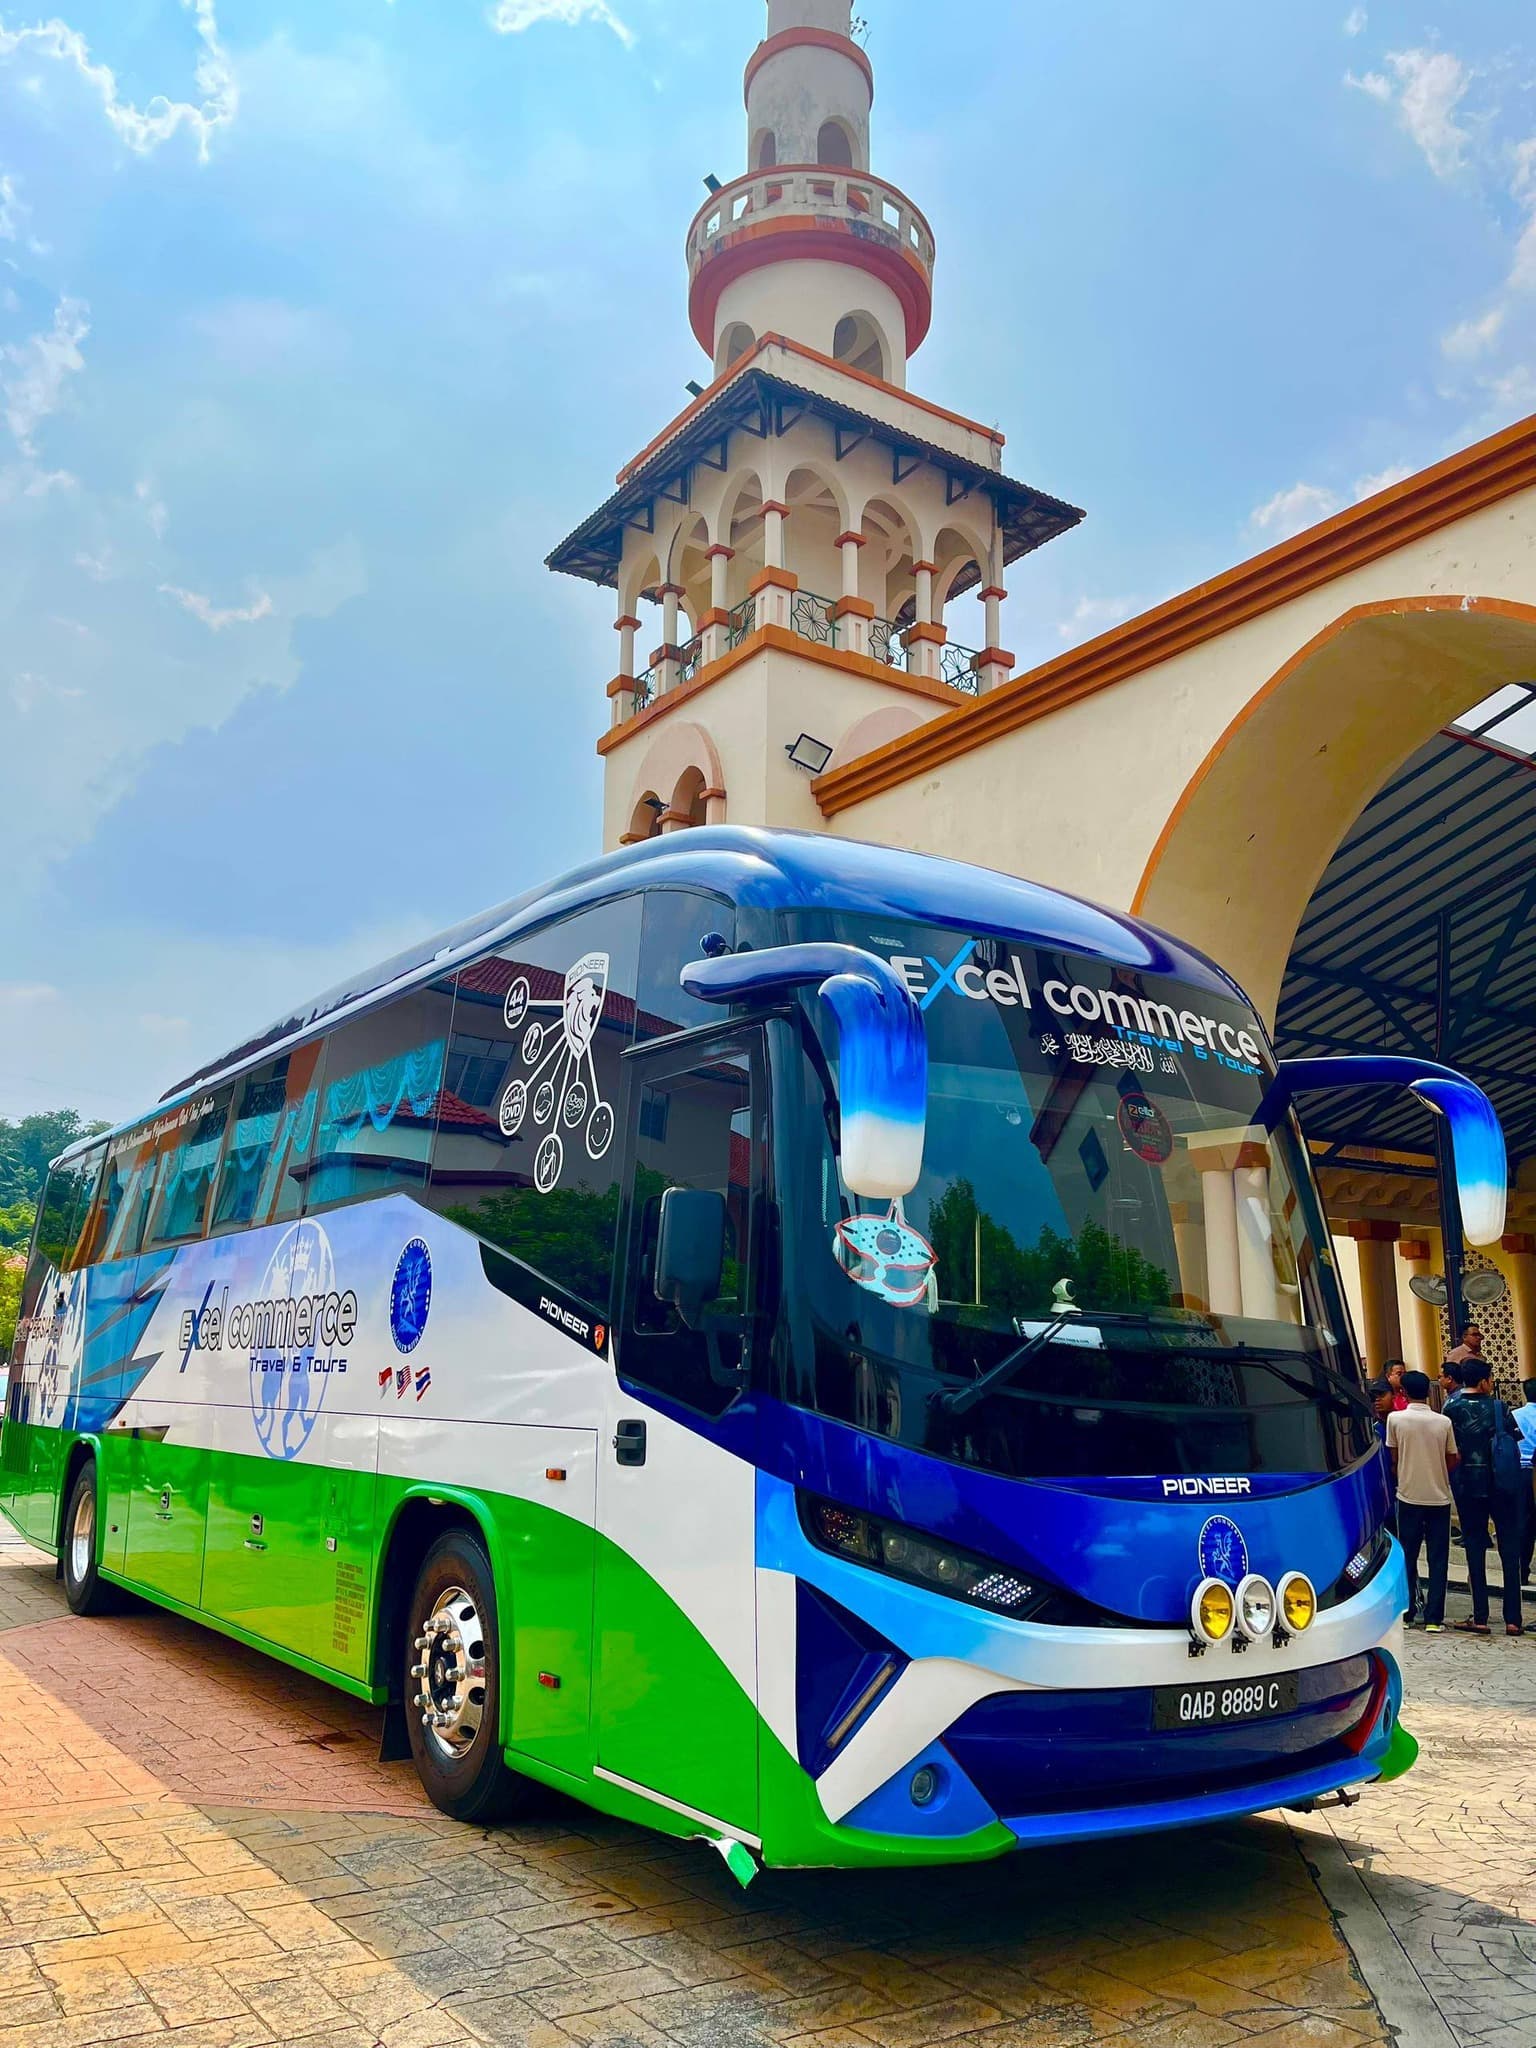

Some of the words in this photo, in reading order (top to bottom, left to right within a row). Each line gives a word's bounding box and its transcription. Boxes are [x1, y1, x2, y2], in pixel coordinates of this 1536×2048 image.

[569, 959, 606, 981] PIONEER
[509, 986, 525, 1008] 44
[1043, 979, 1261, 1065] commerce
[1111, 1025, 1183, 1053] Travel
[504, 1103, 521, 1120] DVD
[228, 1289, 358, 1349] commerce
[539, 1296, 589, 1339] PIONEER
[250, 1356, 286, 1373] Travel
[306, 1356, 347, 1373] Tours
[1162, 1477, 1251, 1497] PIONEER
[1180, 1690, 1215, 1721] QAB
[1221, 1684, 1264, 1717] 8889
[1268, 1682, 1279, 1710] C
